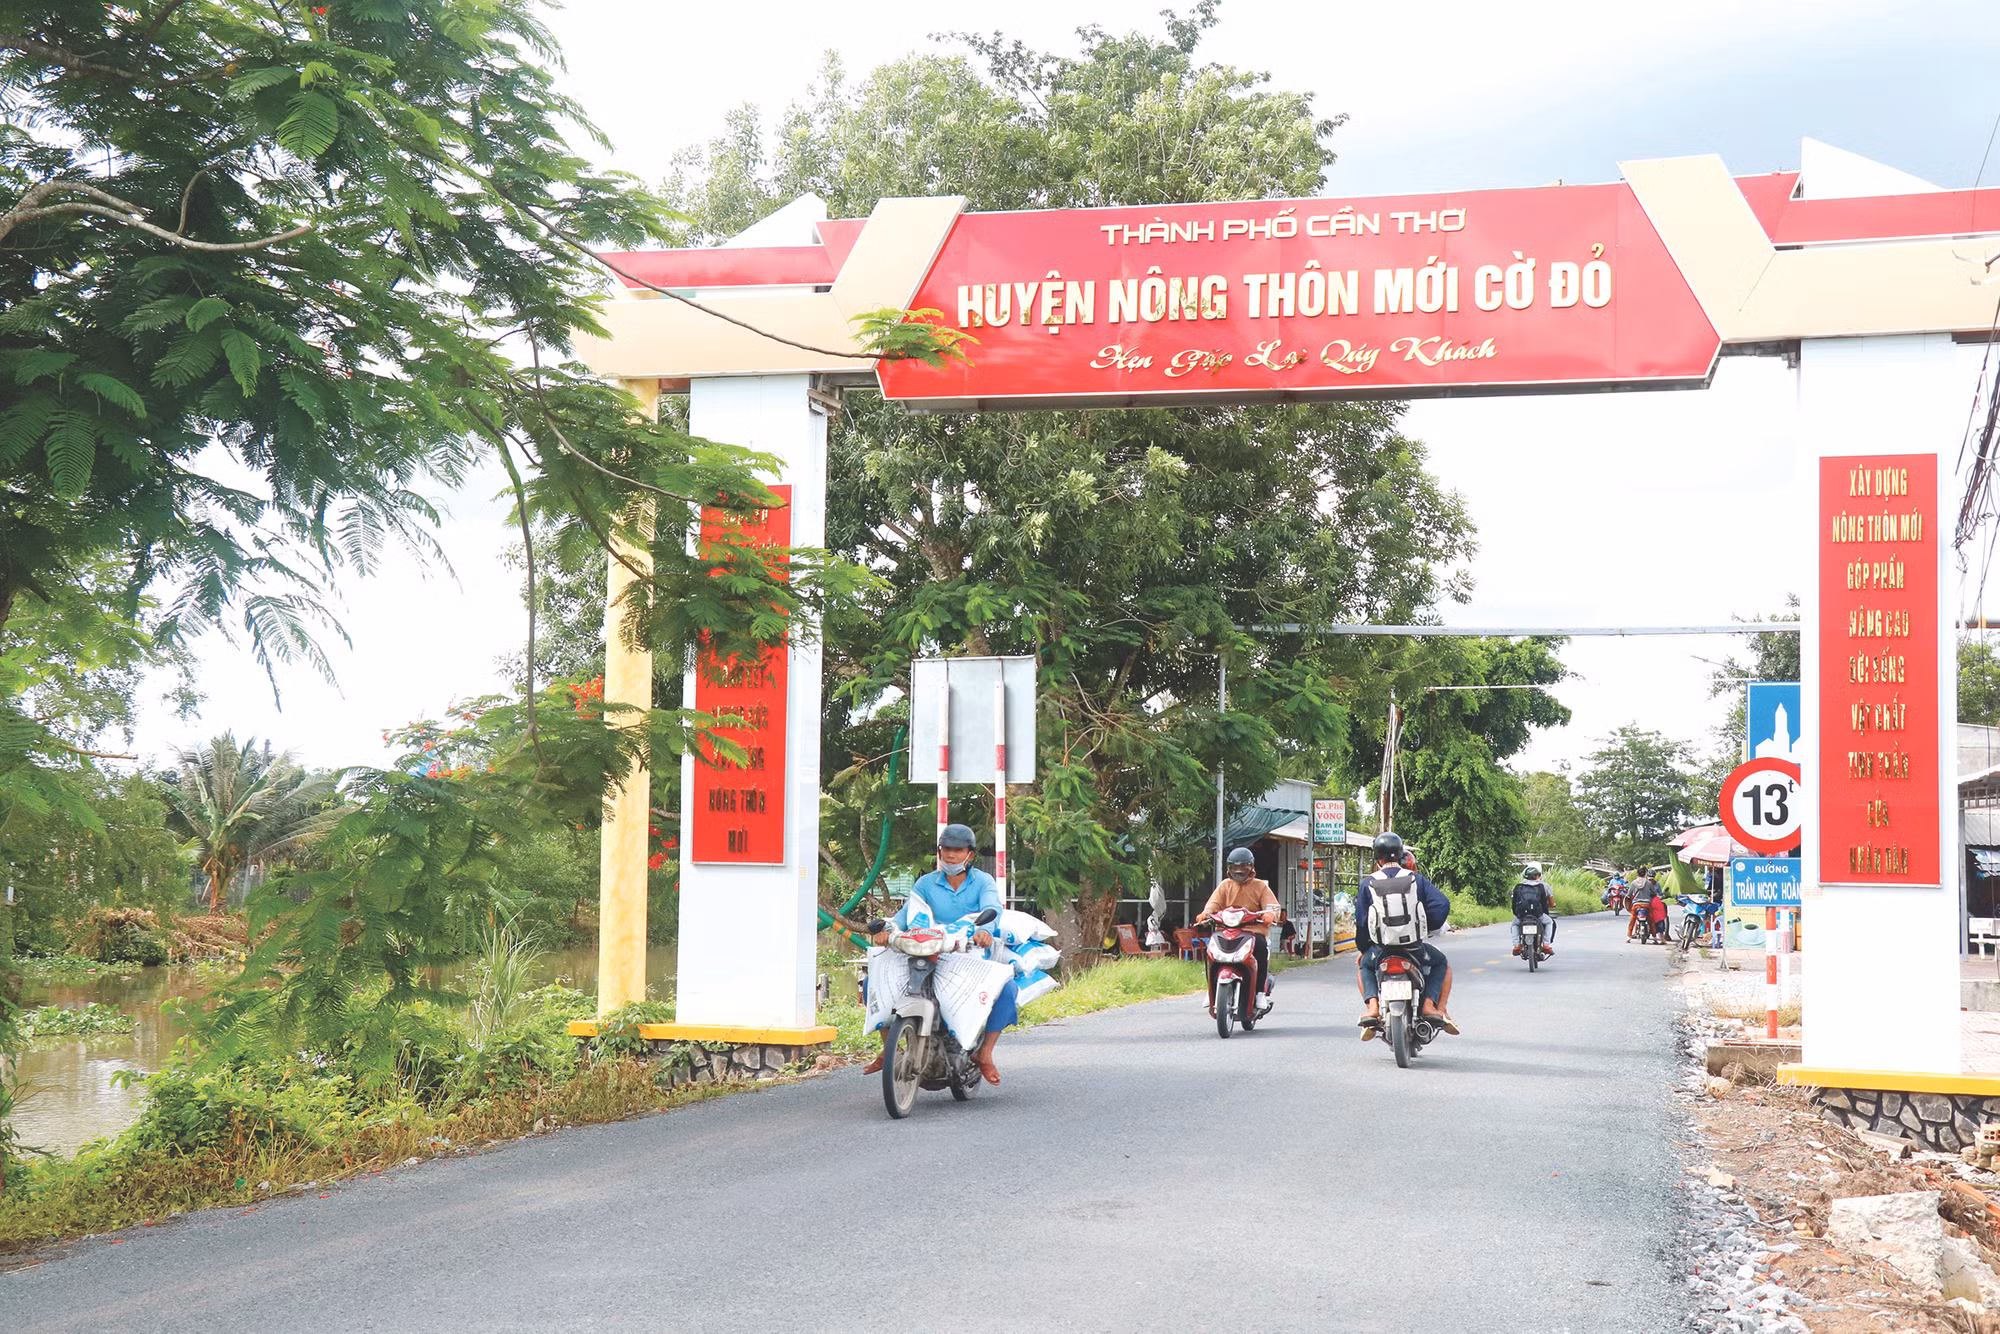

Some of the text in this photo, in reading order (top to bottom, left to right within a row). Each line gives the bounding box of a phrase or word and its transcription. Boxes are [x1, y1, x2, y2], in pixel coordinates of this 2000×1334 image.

[1100, 205, 1467, 245] THÀNH PHỐ CẦN THƠ
[957, 242, 1612, 334] HUYỆN NÔNG THÔN MỚI CỜ ĐỎ
[1089, 343, 1154, 373] Hẹn
[1163, 347, 1234, 378] Gặp
[1243, 338, 1309, 372] Lại
[1389, 335, 1499, 368] Khách
[1849, 463, 1908, 502] XÂY DỰNG
[1832, 507, 1923, 543] NÔNG THÔN MỚI
[1847, 556, 1870, 590] GÓP
[1848, 604, 1909, 638] NÂNG CAO
[1849, 646, 1905, 683] ĐỜI SỐNG
[1851, 692, 1907, 736] VẬT CHẤT
[1848, 741, 1909, 779] TINH THẦN
[708, 783, 767, 815] NÔNG THÔN
[1329, 802, 1344, 810] Phê
[1867, 790, 1889, 827] CỦA
[727, 824, 749, 854] MỚI
[1849, 840, 1909, 874] NHÂN DÂN
[1754, 862, 1789, 874] ĐƯỜNG
[1735, 876, 1756, 900] TRẦN
[1757, 881, 1778, 902] NGỌC
